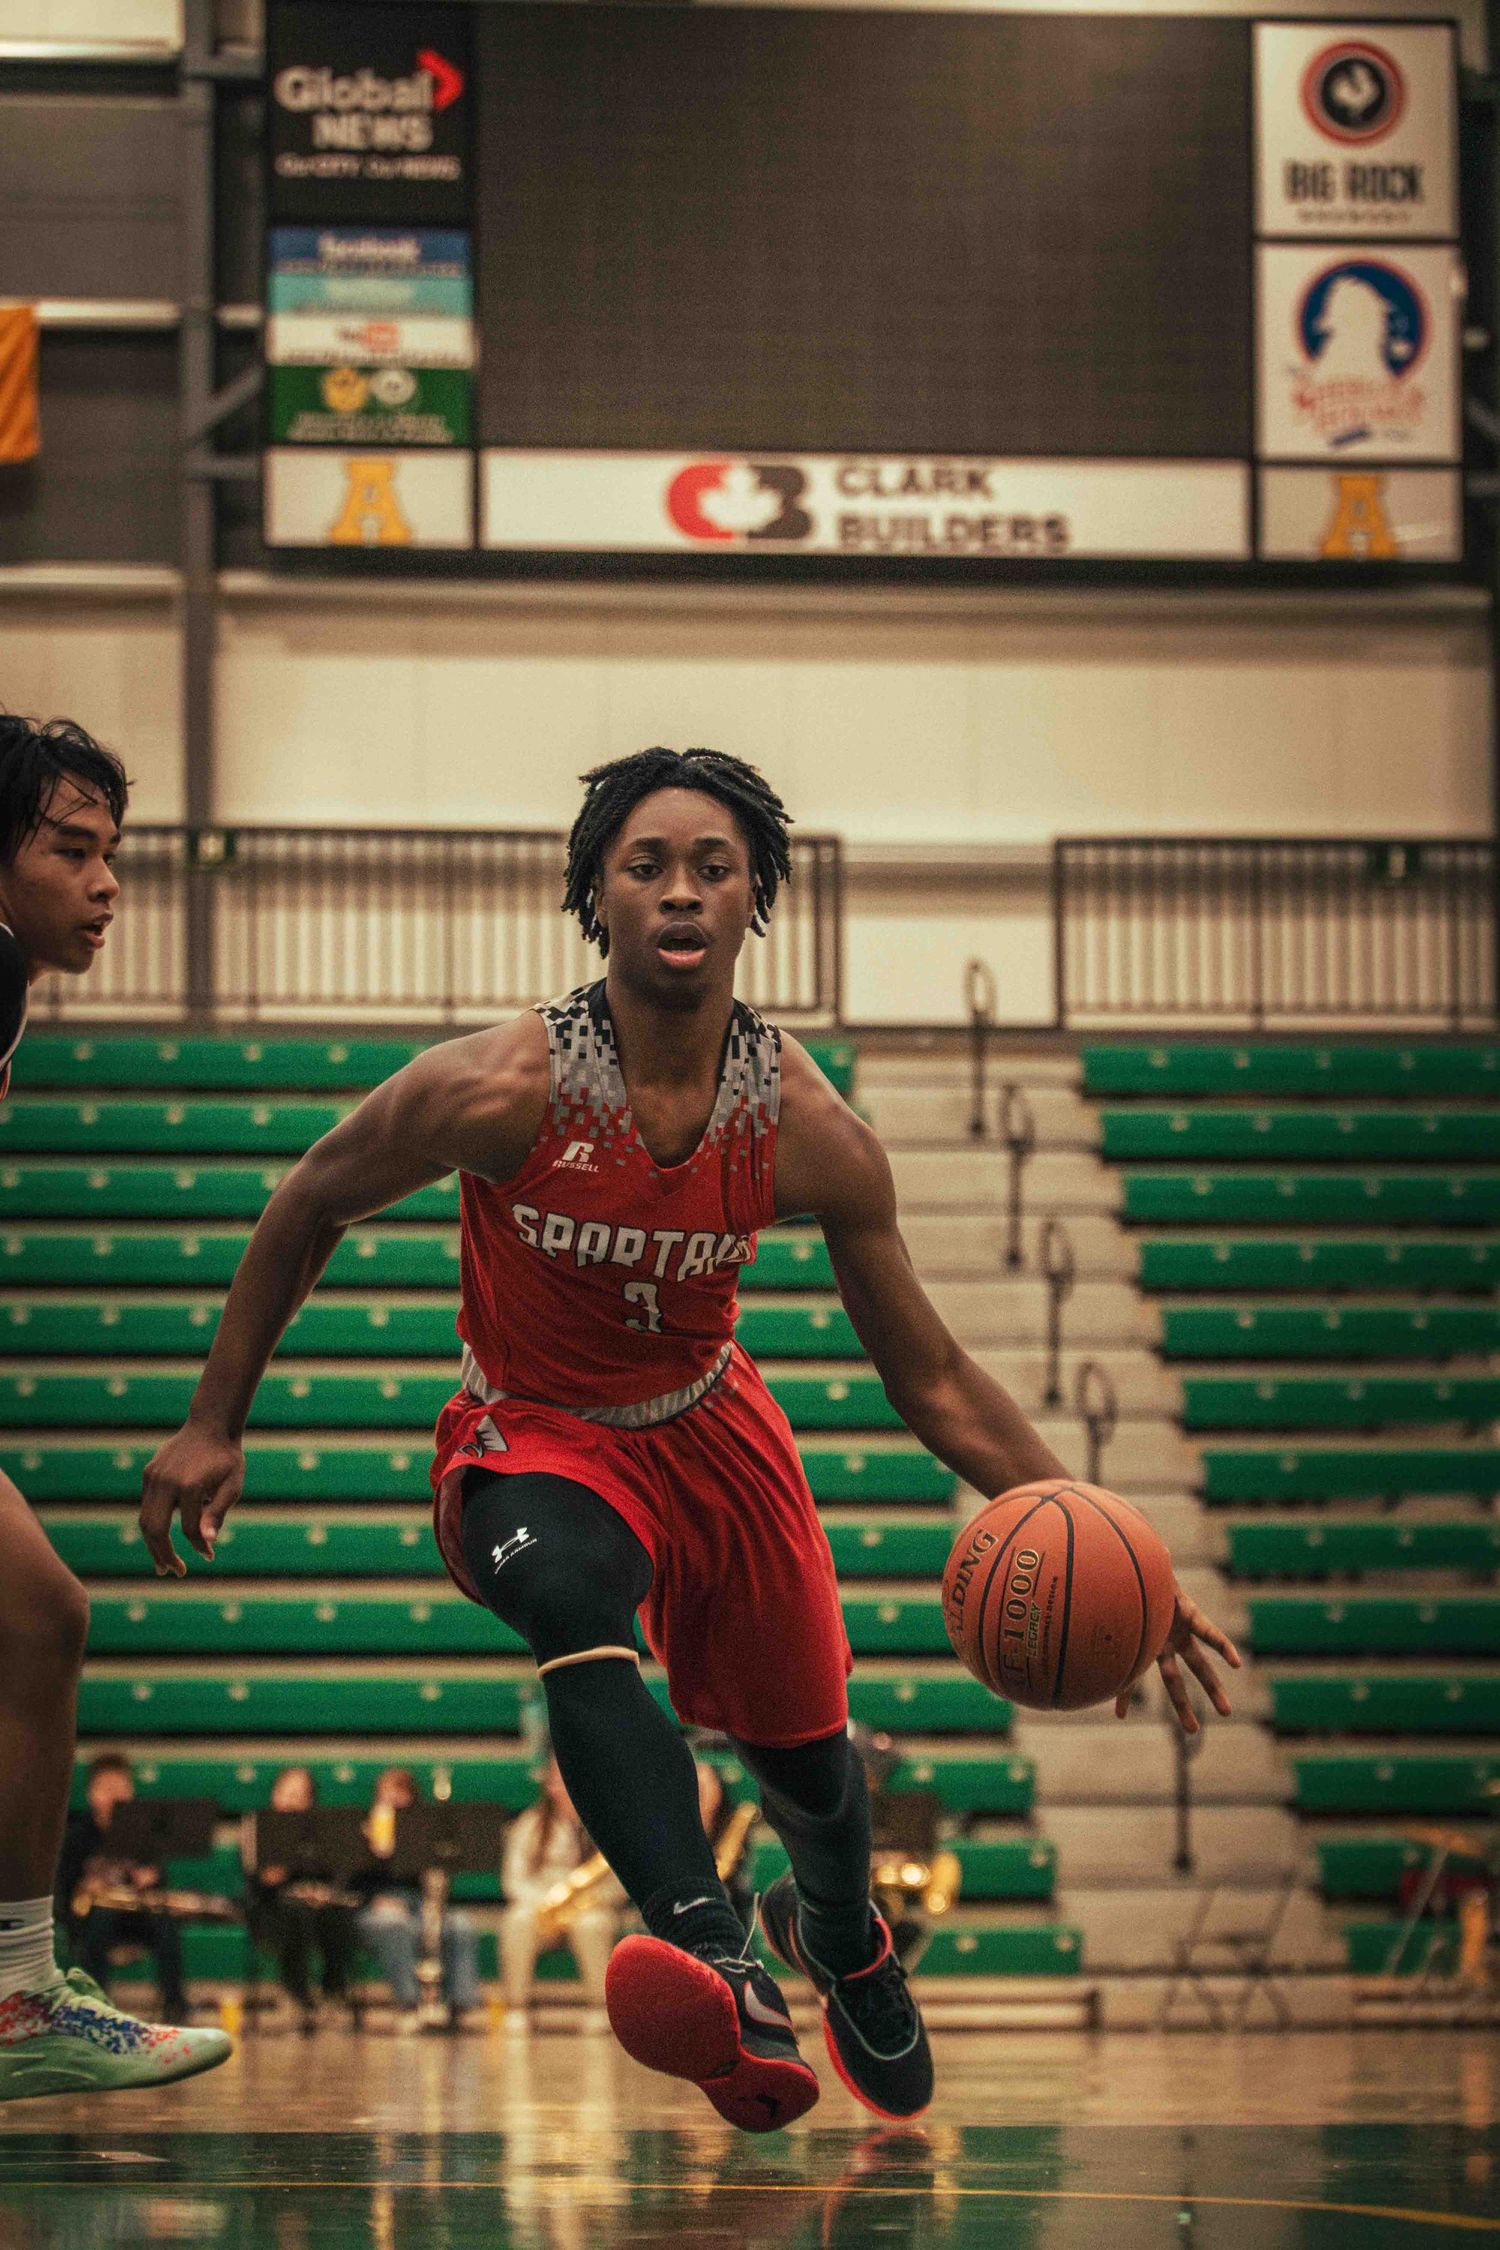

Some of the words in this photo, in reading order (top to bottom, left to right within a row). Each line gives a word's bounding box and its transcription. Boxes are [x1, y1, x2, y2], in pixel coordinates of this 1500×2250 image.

[275, 65, 434, 112] Global
[312, 114, 433, 150] NEWS
[1286, 163, 1334, 203] BIG
[1347, 164, 1424, 205] ROCK
[836, 464, 993, 500] CLARK
[837, 512, 1070, 552] BUILDERS
[552, 1159, 600, 1173] RUSSELL
[623, 1281, 662, 1333] 3
